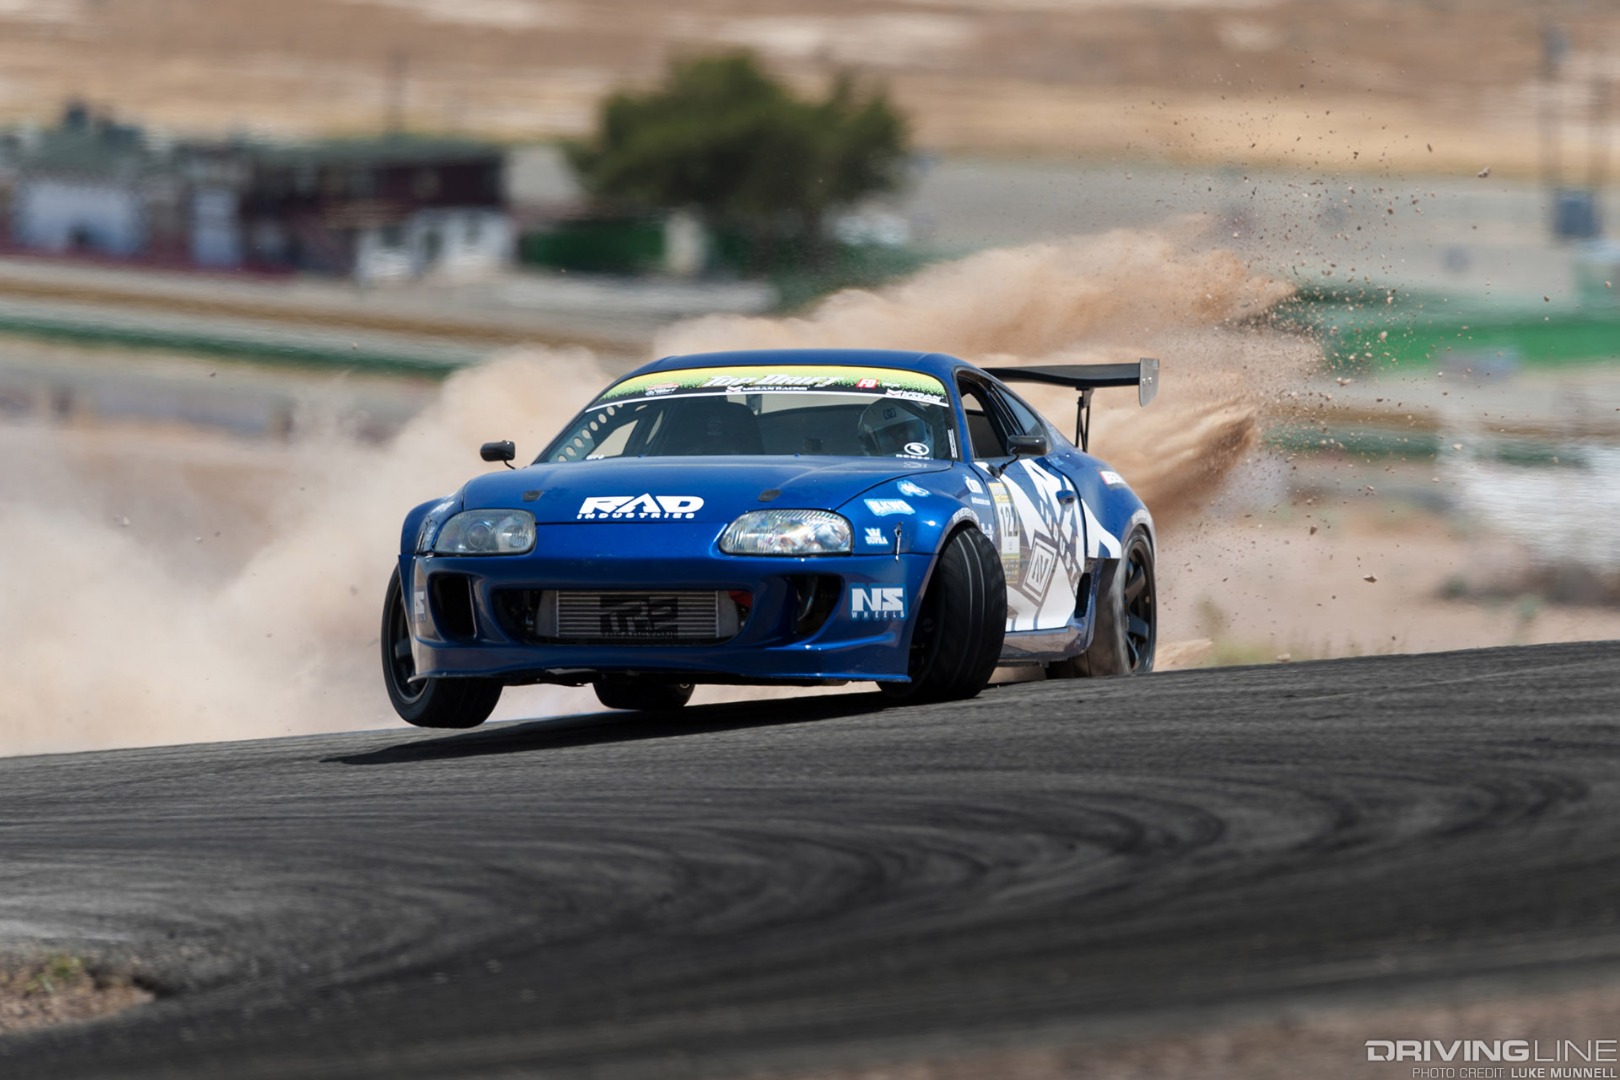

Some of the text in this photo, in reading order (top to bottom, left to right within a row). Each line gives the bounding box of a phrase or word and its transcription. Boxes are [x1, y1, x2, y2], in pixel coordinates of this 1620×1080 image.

[578, 492, 705, 514] RAD
[576, 512, 695, 520] INDUSTRIES
[851, 611, 905, 619] WHEELS
